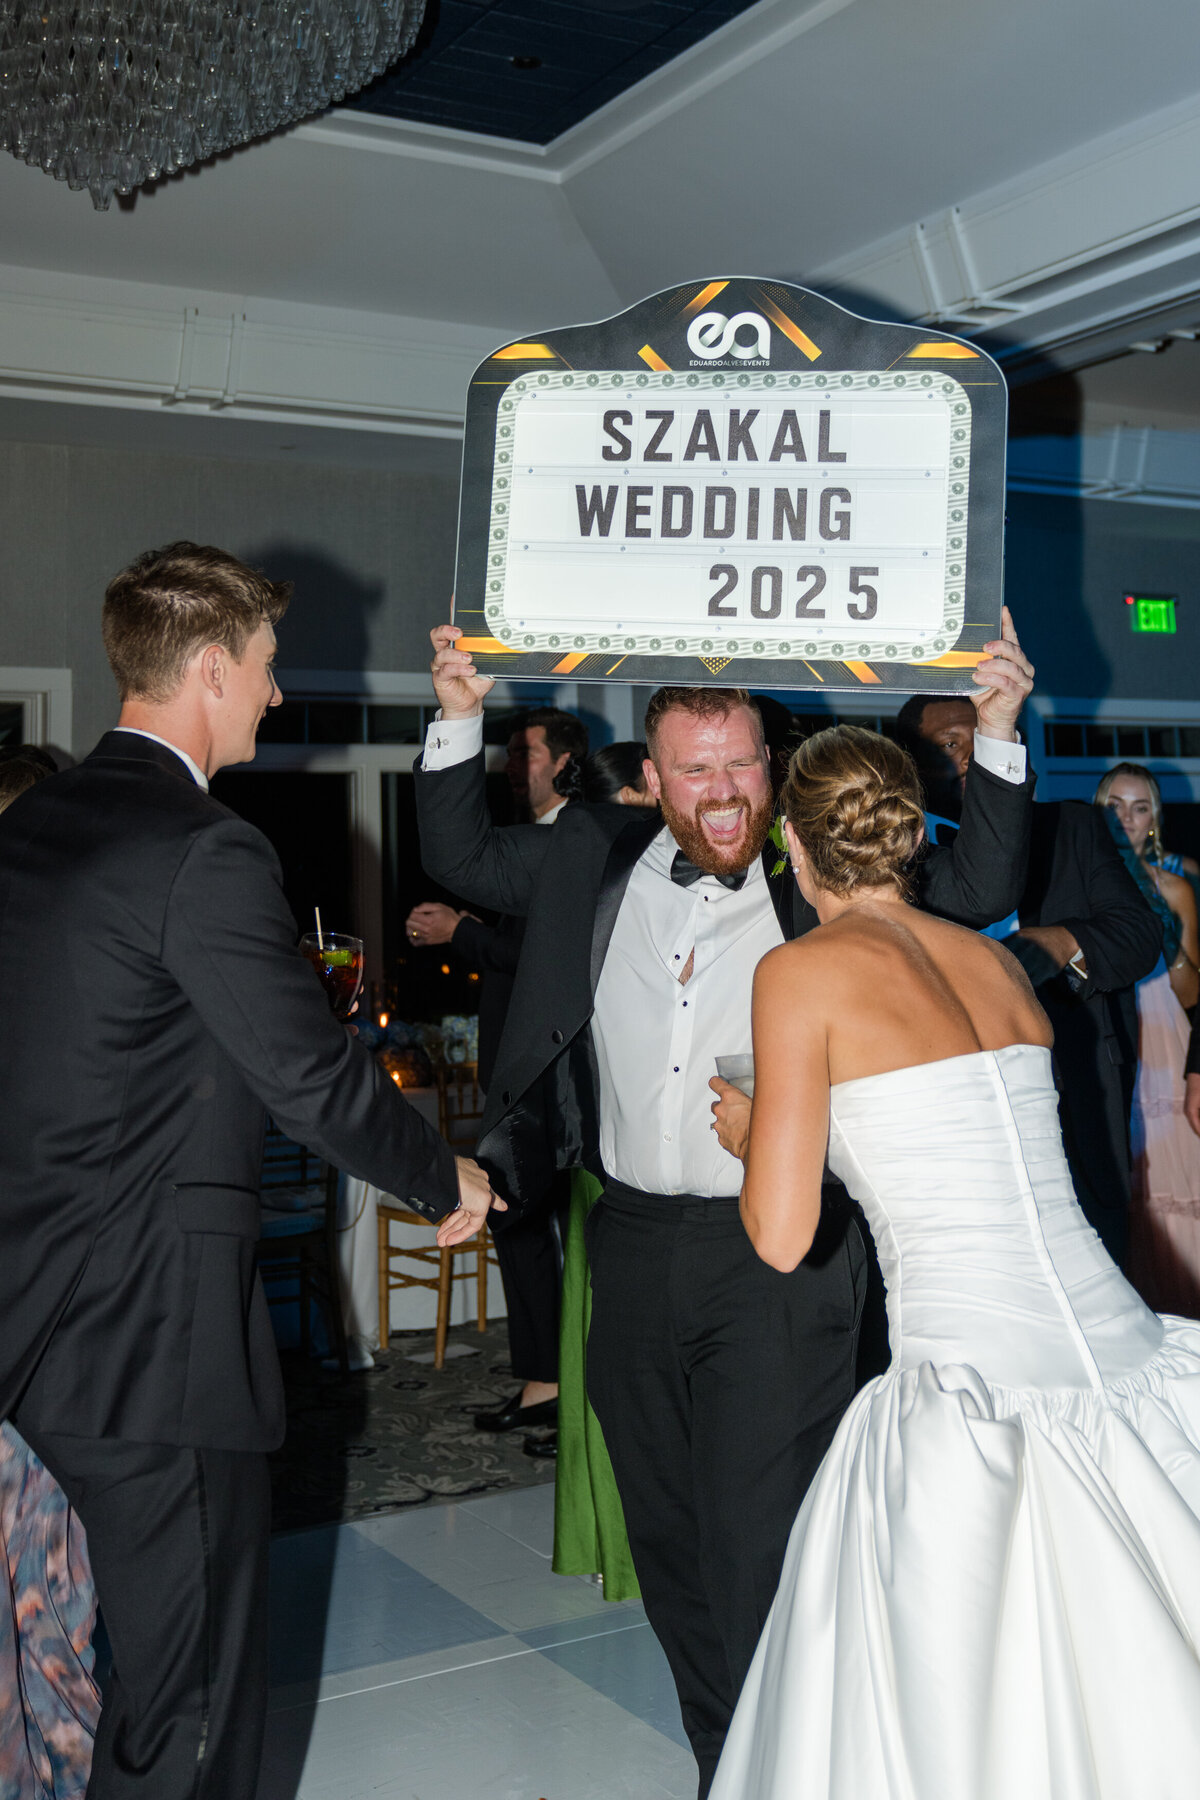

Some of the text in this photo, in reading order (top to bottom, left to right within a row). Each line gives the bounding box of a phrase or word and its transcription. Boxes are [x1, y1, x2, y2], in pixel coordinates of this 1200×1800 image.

[602, 408, 847, 463] SZAKAL
[575, 484, 852, 541] WEDDING
[708, 563, 880, 621] 2025
